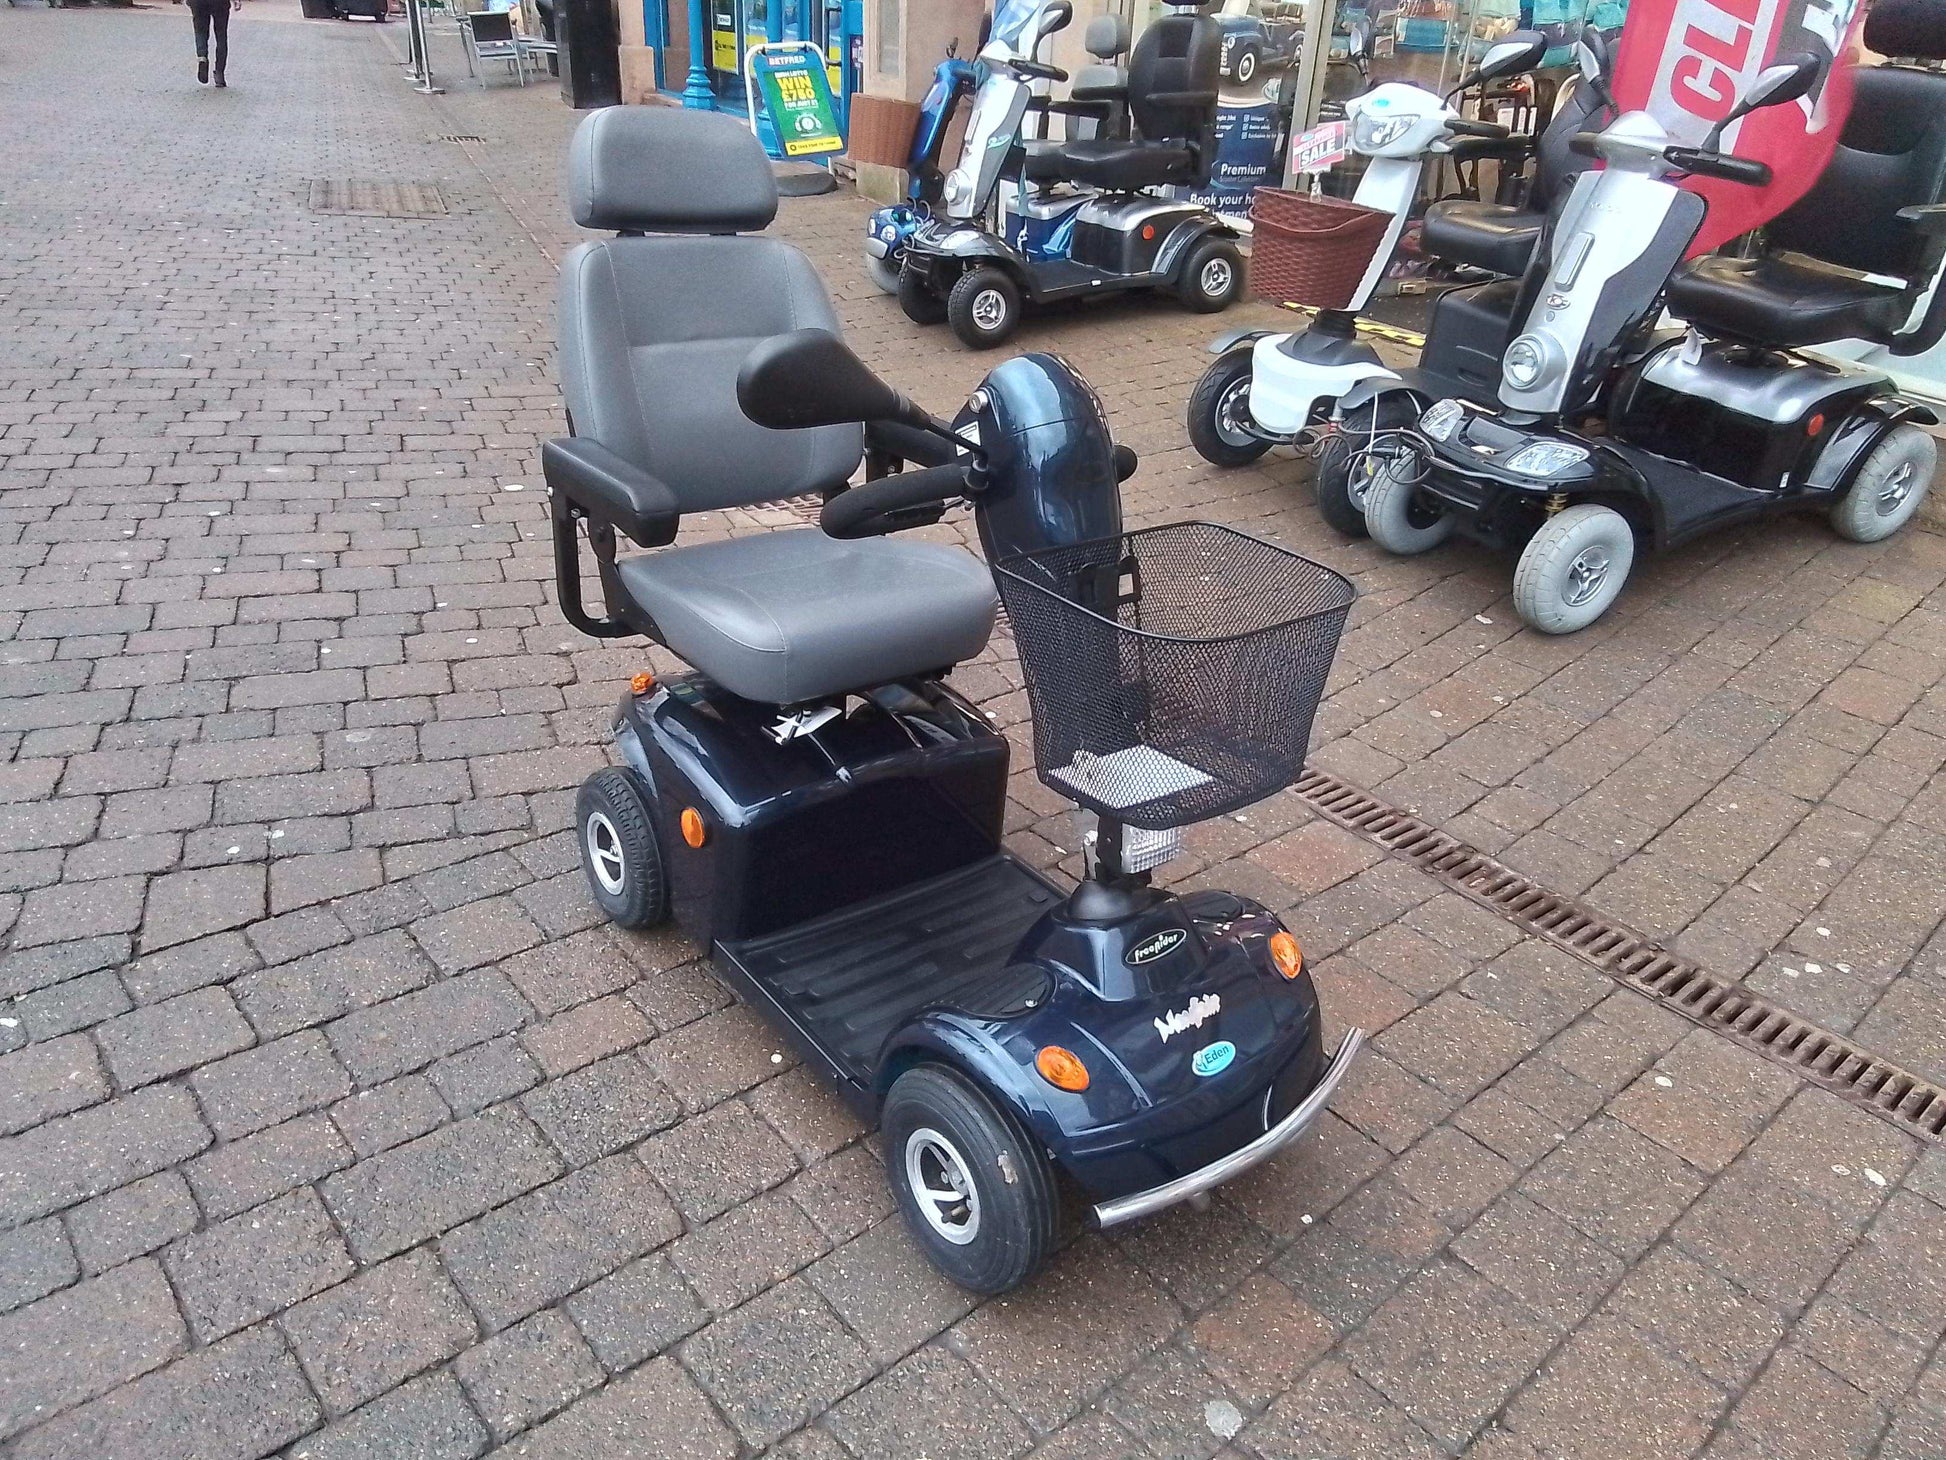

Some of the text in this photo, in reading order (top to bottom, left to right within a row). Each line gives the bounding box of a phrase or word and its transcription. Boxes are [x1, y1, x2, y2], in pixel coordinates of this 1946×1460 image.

[767, 55, 806, 67] BETFRED
[1670, 0, 1761, 122] CL
[776, 75, 812, 90] WIN
[781, 88, 815, 102] £750
[1301, 139, 1336, 166] SALE
[1221, 163, 1266, 176] Premium
[1190, 192, 1217, 206] Book
[1219, 195, 1244, 208] your
[1205, 1045, 1230, 1065] Eden
